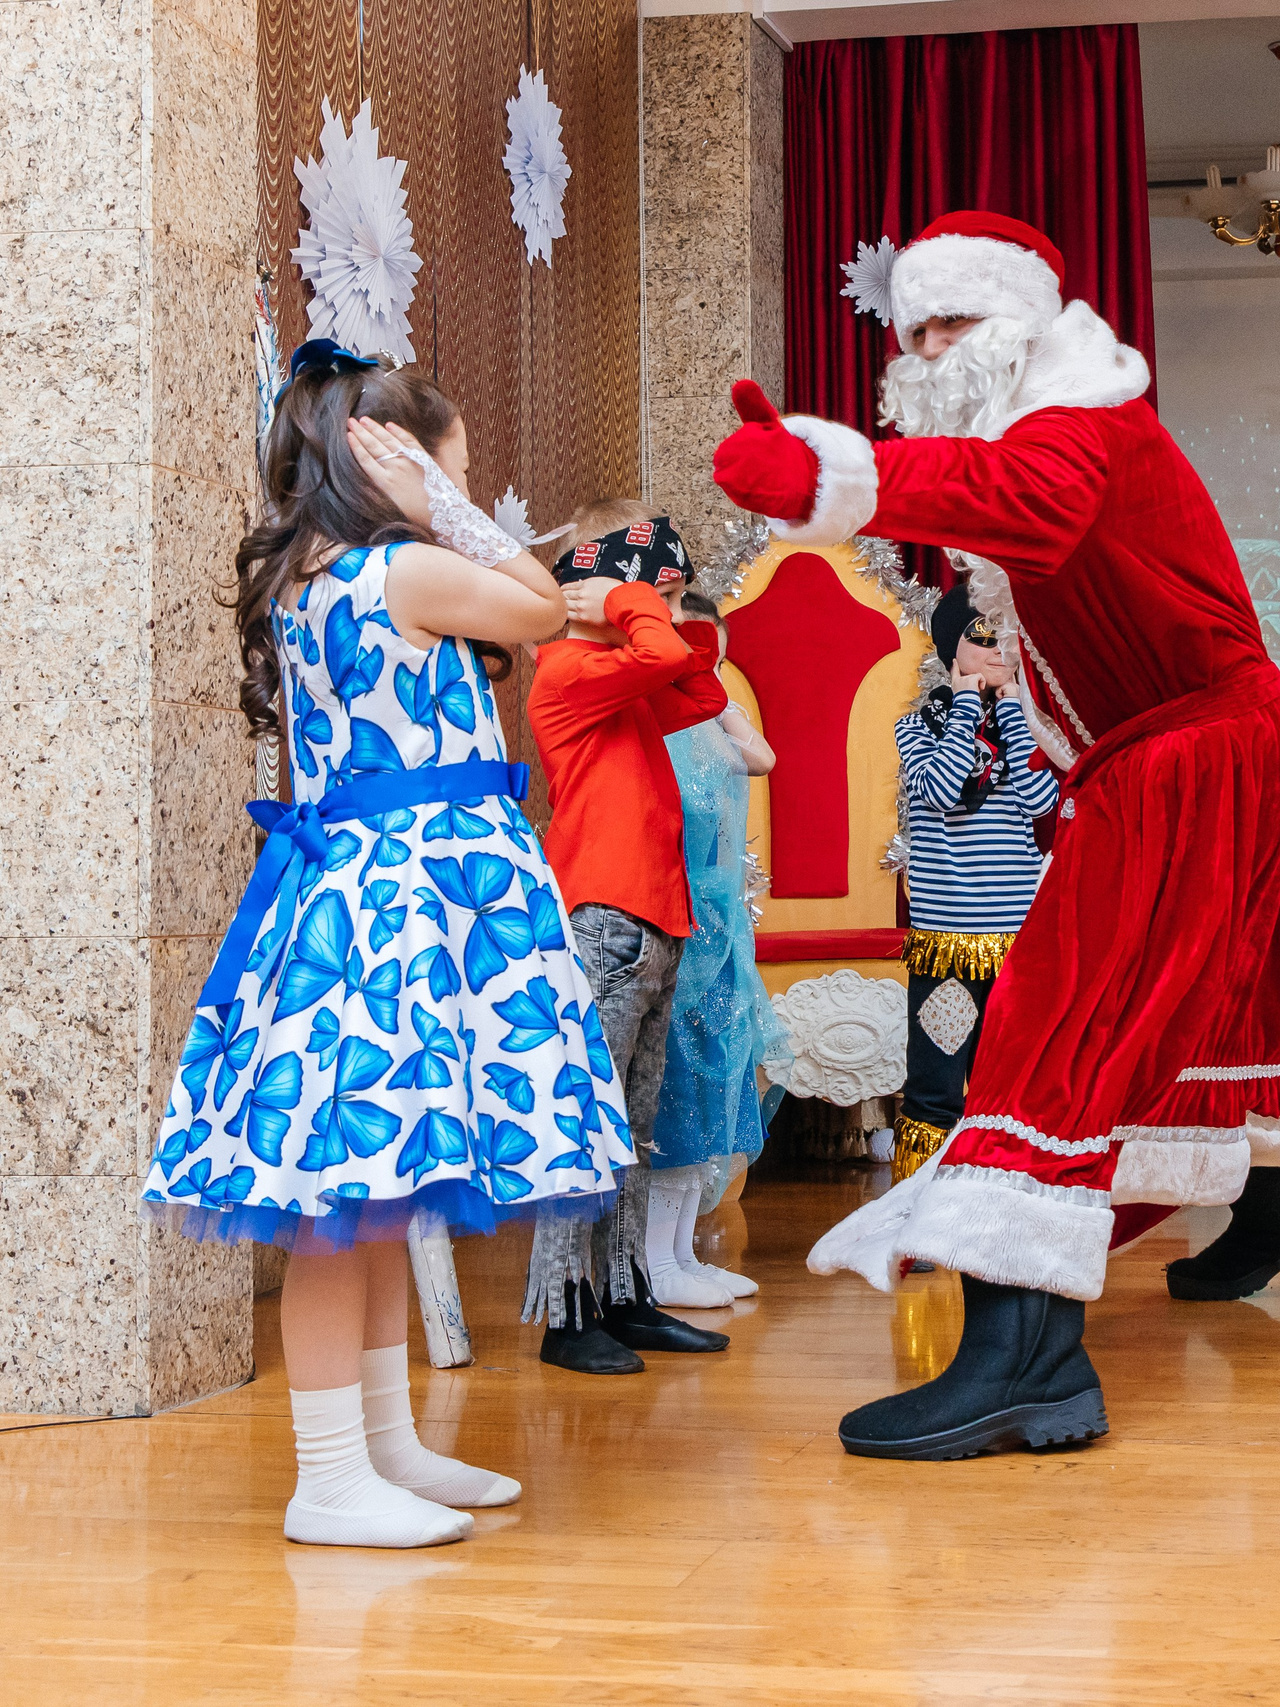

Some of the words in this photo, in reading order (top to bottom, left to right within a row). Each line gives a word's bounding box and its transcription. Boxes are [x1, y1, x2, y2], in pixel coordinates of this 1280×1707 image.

[625, 522, 654, 547] 88
[572, 542, 601, 569] 88
[654, 566, 682, 586] 8
